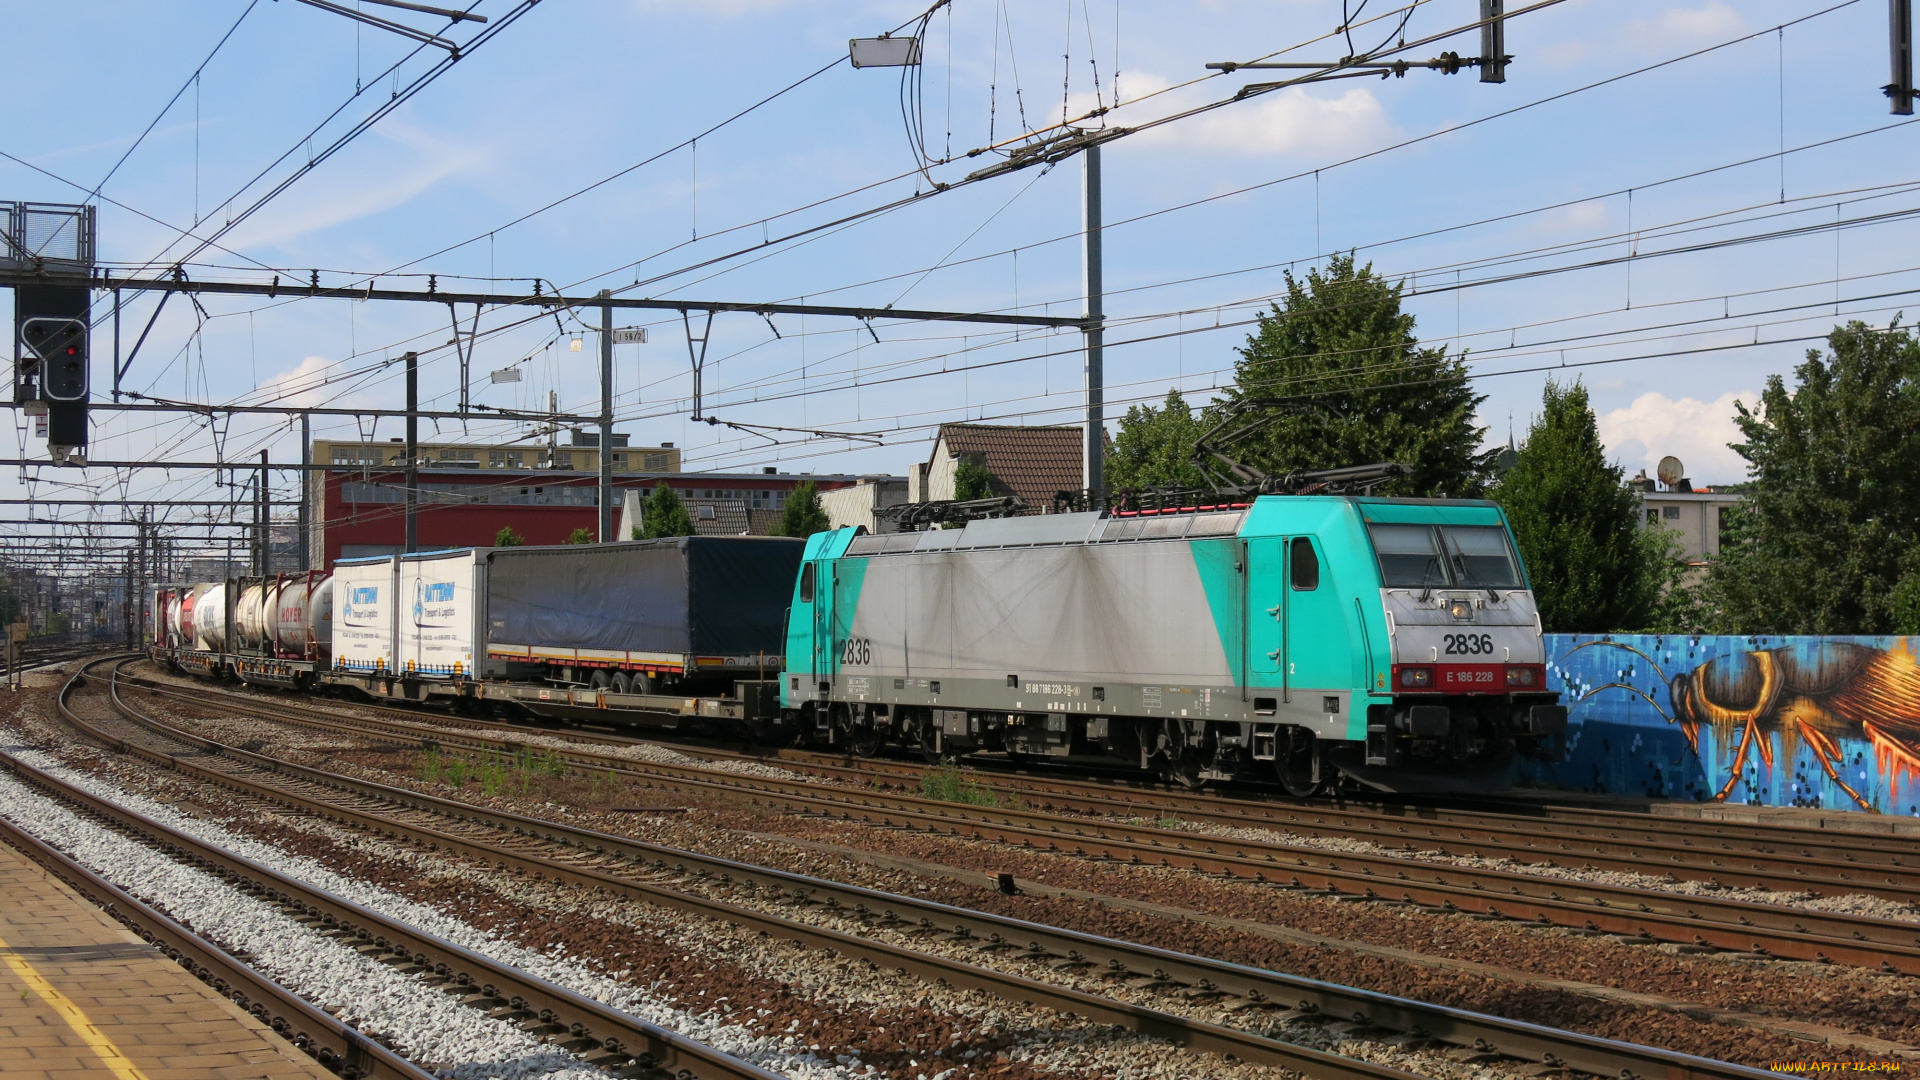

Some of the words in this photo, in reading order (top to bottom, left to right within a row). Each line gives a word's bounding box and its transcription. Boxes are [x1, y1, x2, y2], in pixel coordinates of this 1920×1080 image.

[281, 607, 302, 623] HOYER
[424, 607, 438, 620] Transport
[441, 606, 455, 620] Logistics
[1443, 633, 1494, 655] 2836
[839, 638, 871, 665] 2836
[1289, 662, 1295, 674] 2
[1446, 671, 1454, 682] E
[1456, 671, 1473, 682] 186
[1475, 671, 1494, 682] 228
[1025, 683, 1031, 693] 91
[1032, 683, 1039, 693] 88
[1039, 683, 1051, 694] 7186
